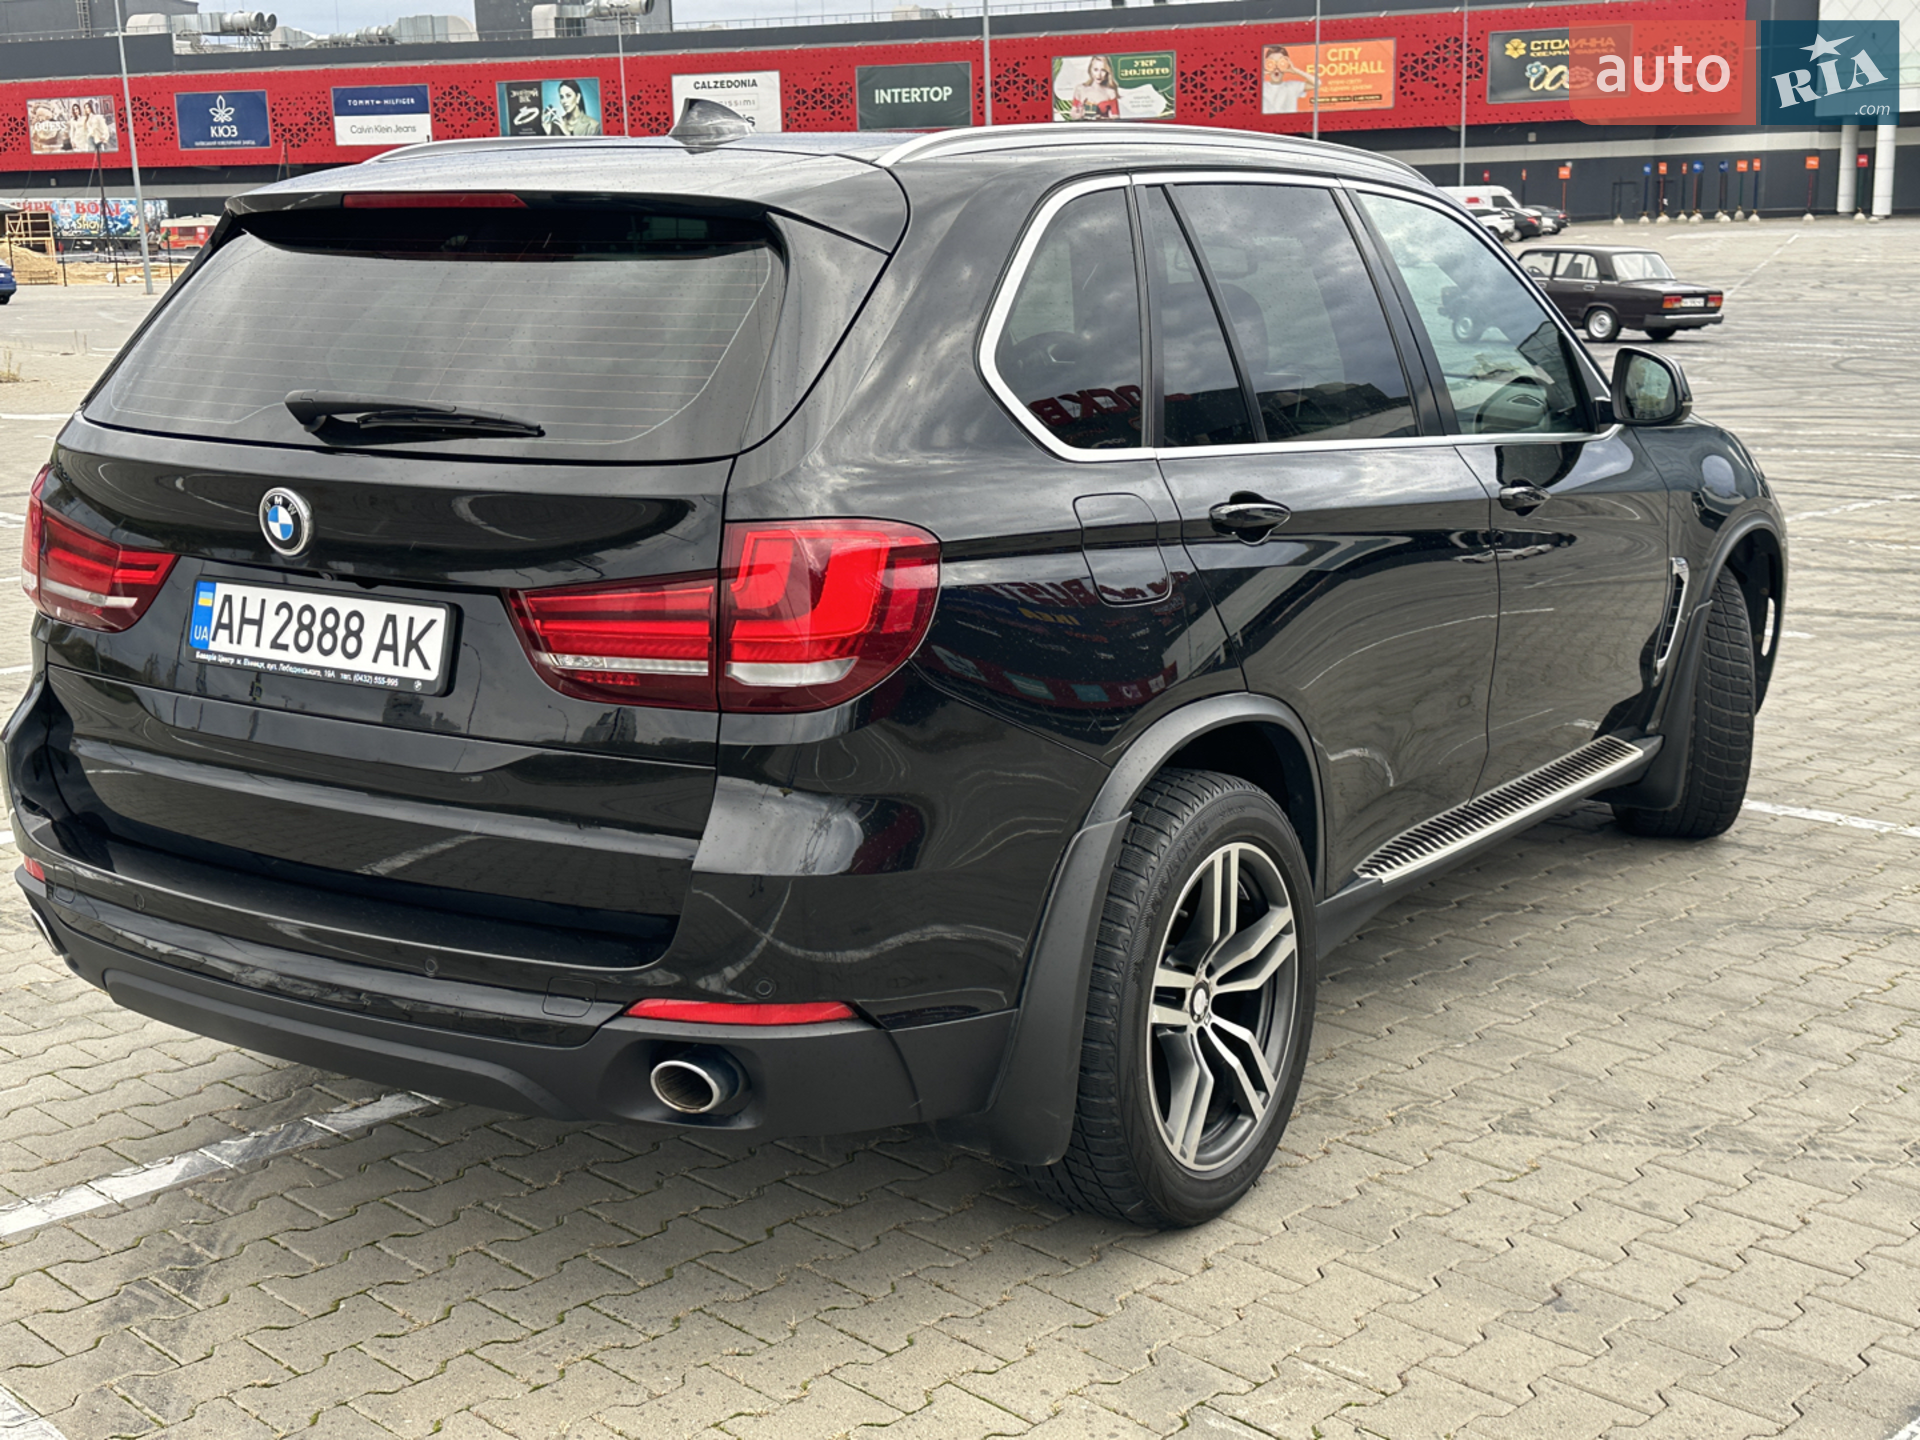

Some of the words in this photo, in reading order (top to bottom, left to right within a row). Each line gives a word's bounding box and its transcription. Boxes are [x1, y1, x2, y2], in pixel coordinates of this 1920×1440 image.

[1326, 47, 1362, 62] CITY
[1132, 59, 1157, 67] УКР
[1306, 60, 1386, 77] FOODHALL
[1120, 67, 1170, 77] ЗОЛОТО
[693, 79, 758, 90] CALZEDONIA
[383, 97, 415, 105] HILFIGER
[875, 86, 953, 105] INTERTOP
[34, 121, 67, 131] GUESS
[210, 125, 238, 138] КЮЗ
[350, 124, 373, 134] Calvin
[375, 124, 392, 133] Klein
[393, 124, 416, 133] Jeans
[194, 625, 208, 641] UA
[211, 594, 266, 648] AH
[270, 601, 365, 660] 2888
[372, 613, 437, 671] AK
